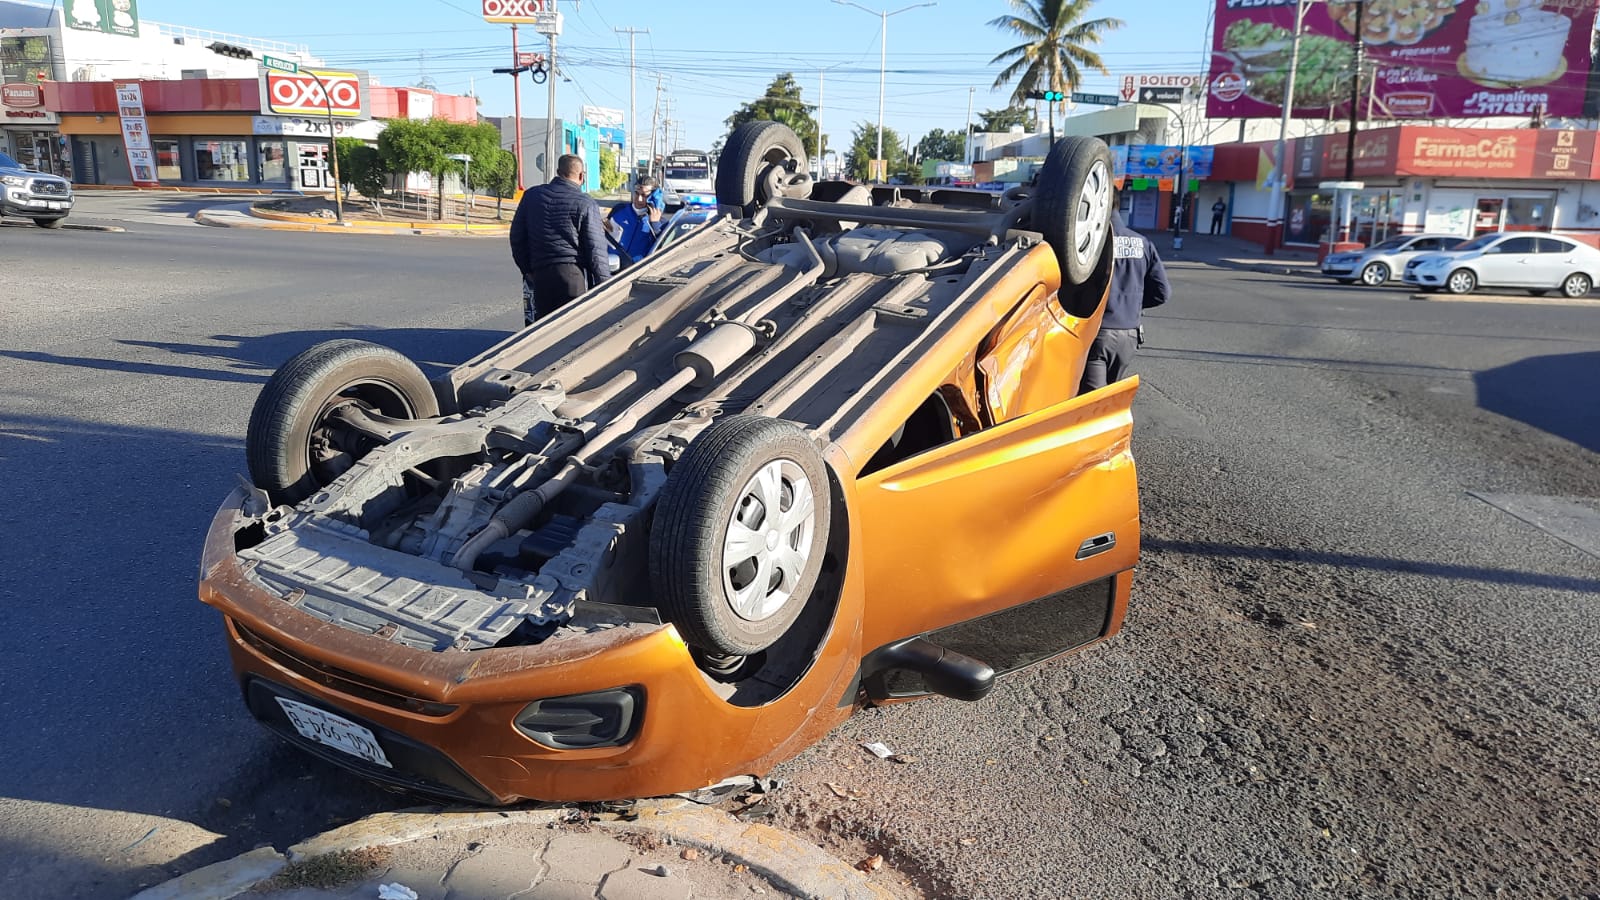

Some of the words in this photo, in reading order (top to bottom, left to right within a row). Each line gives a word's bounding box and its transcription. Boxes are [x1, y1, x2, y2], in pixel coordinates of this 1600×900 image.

[485, 0, 541, 16] OXXO
[1140, 76, 1199, 86] BOLETOS
[273, 79, 357, 107] OXXO
[1331, 140, 1388, 160] FaraCon
